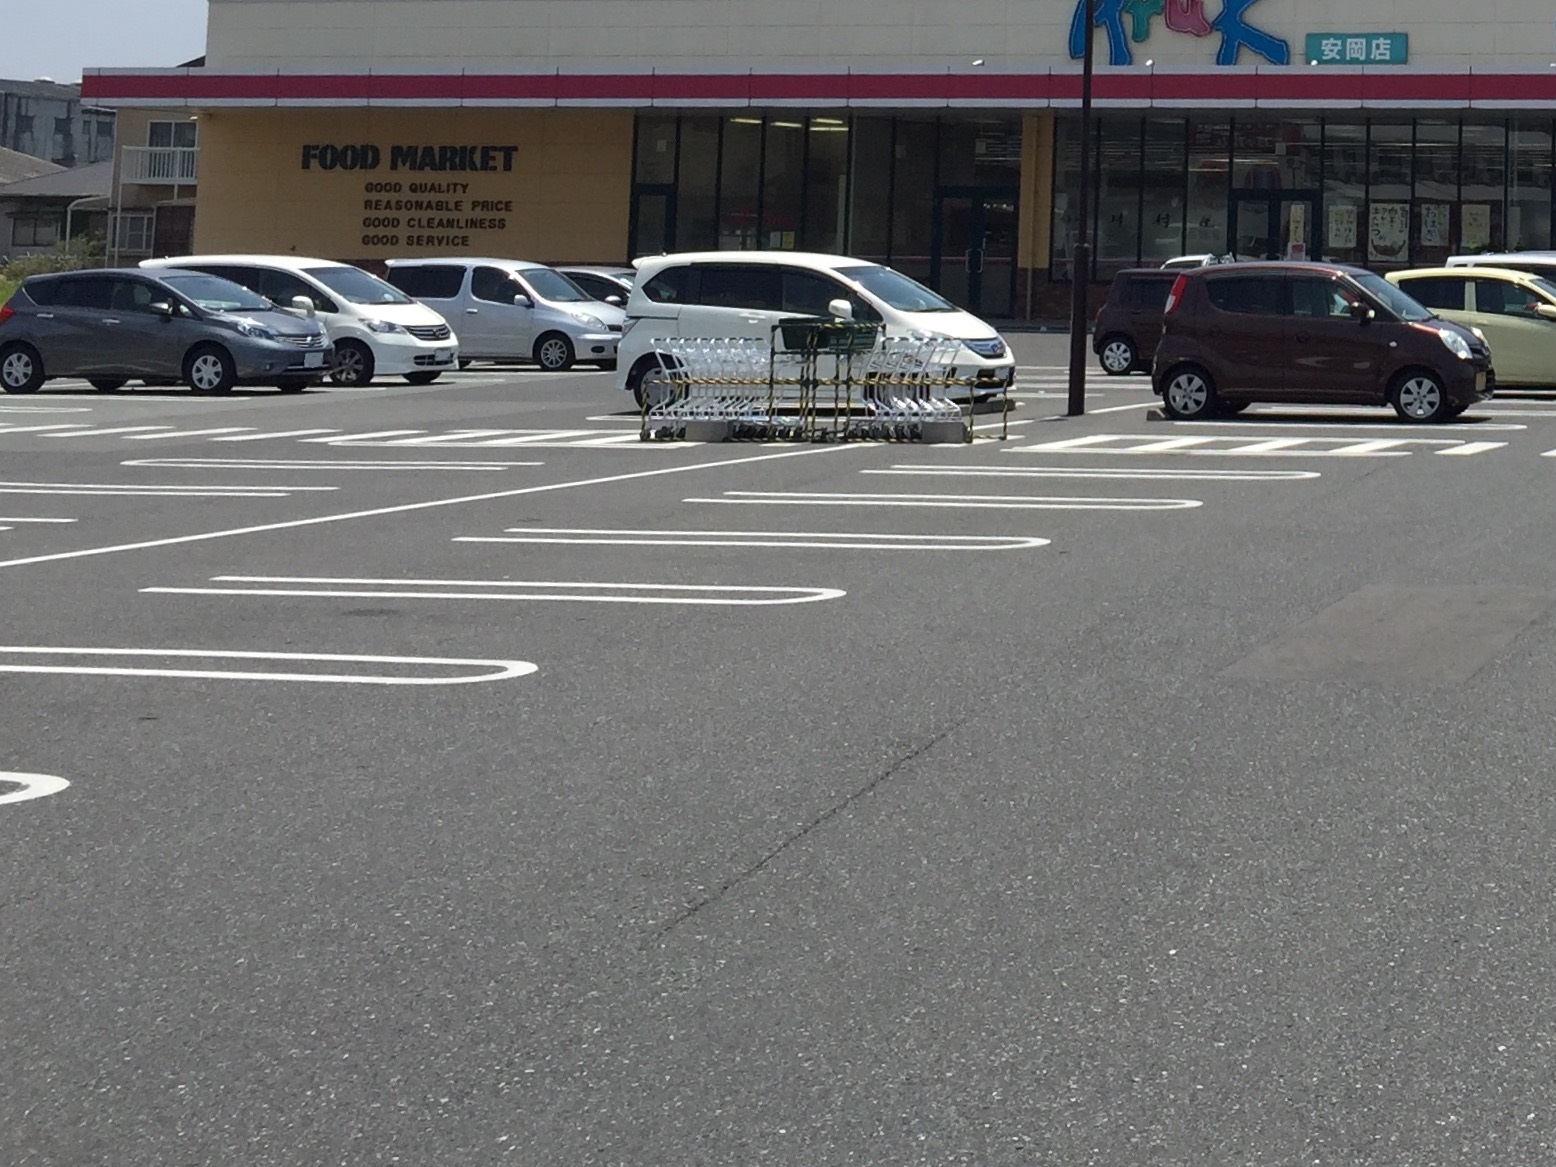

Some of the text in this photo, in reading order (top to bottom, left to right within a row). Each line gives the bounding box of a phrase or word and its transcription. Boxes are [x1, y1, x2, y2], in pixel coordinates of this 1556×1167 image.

[1321, 37, 1391, 60] 安岡店
[301, 144, 519, 172] FOOD MARKET
[364, 182, 469, 194] GOOD QUALITY
[363, 200, 513, 212] REASONABLE PRICE
[362, 217, 507, 230] GOOD CLEANLINESS
[361, 234, 470, 247] GOOD SERVICE
